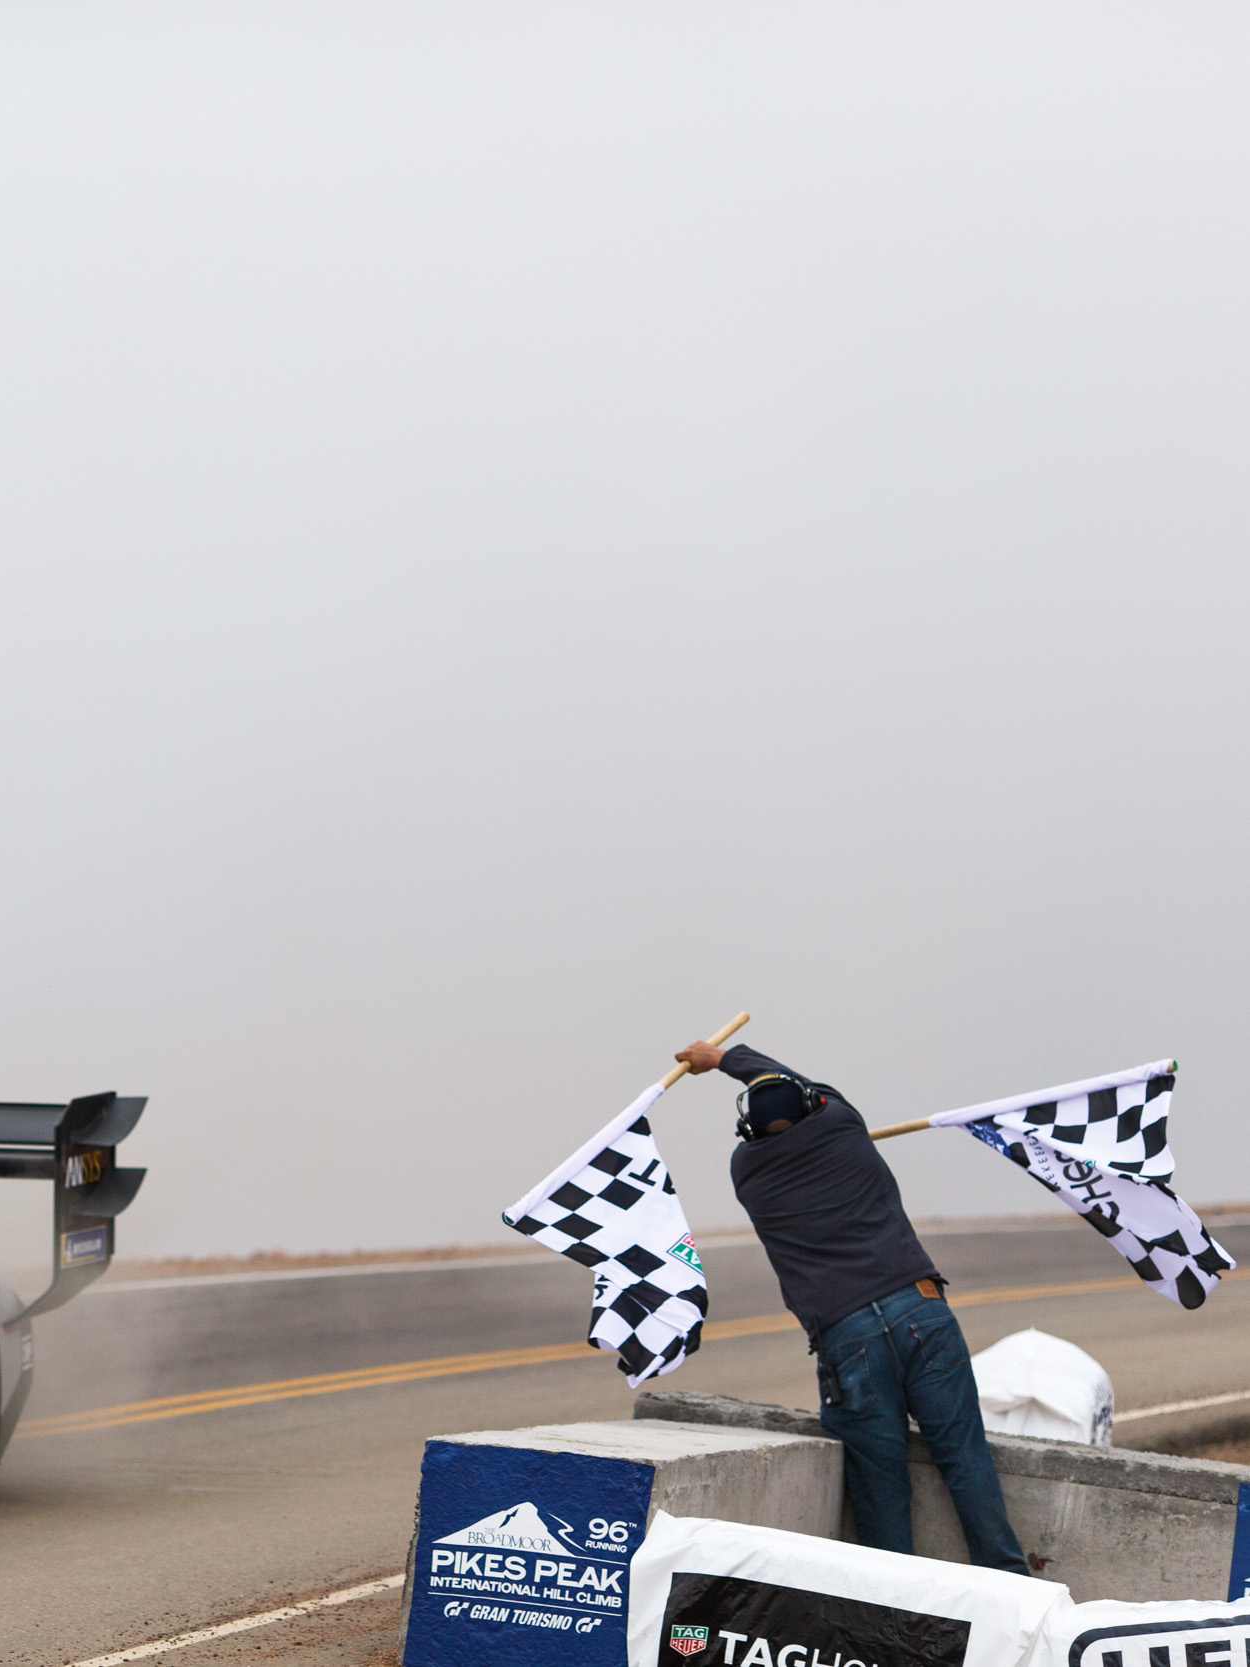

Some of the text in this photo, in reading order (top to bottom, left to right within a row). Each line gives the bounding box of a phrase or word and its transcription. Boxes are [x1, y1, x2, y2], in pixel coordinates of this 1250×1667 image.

[65, 1150, 102, 1188] ANSYS
[467, 1531, 551, 1552] BROADMOOR
[585, 1540, 628, 1554] RUNNING
[431, 1549, 625, 1594] PIKES PEAK
[430, 1576, 622, 1608] INTERNATIONAL HILL CLIMB
[470, 1604, 510, 1623] GRAN
[512, 1610, 573, 1631] TURISMO
[675, 1627, 705, 1639] TAG
[672, 1639, 705, 1654] HEUER
